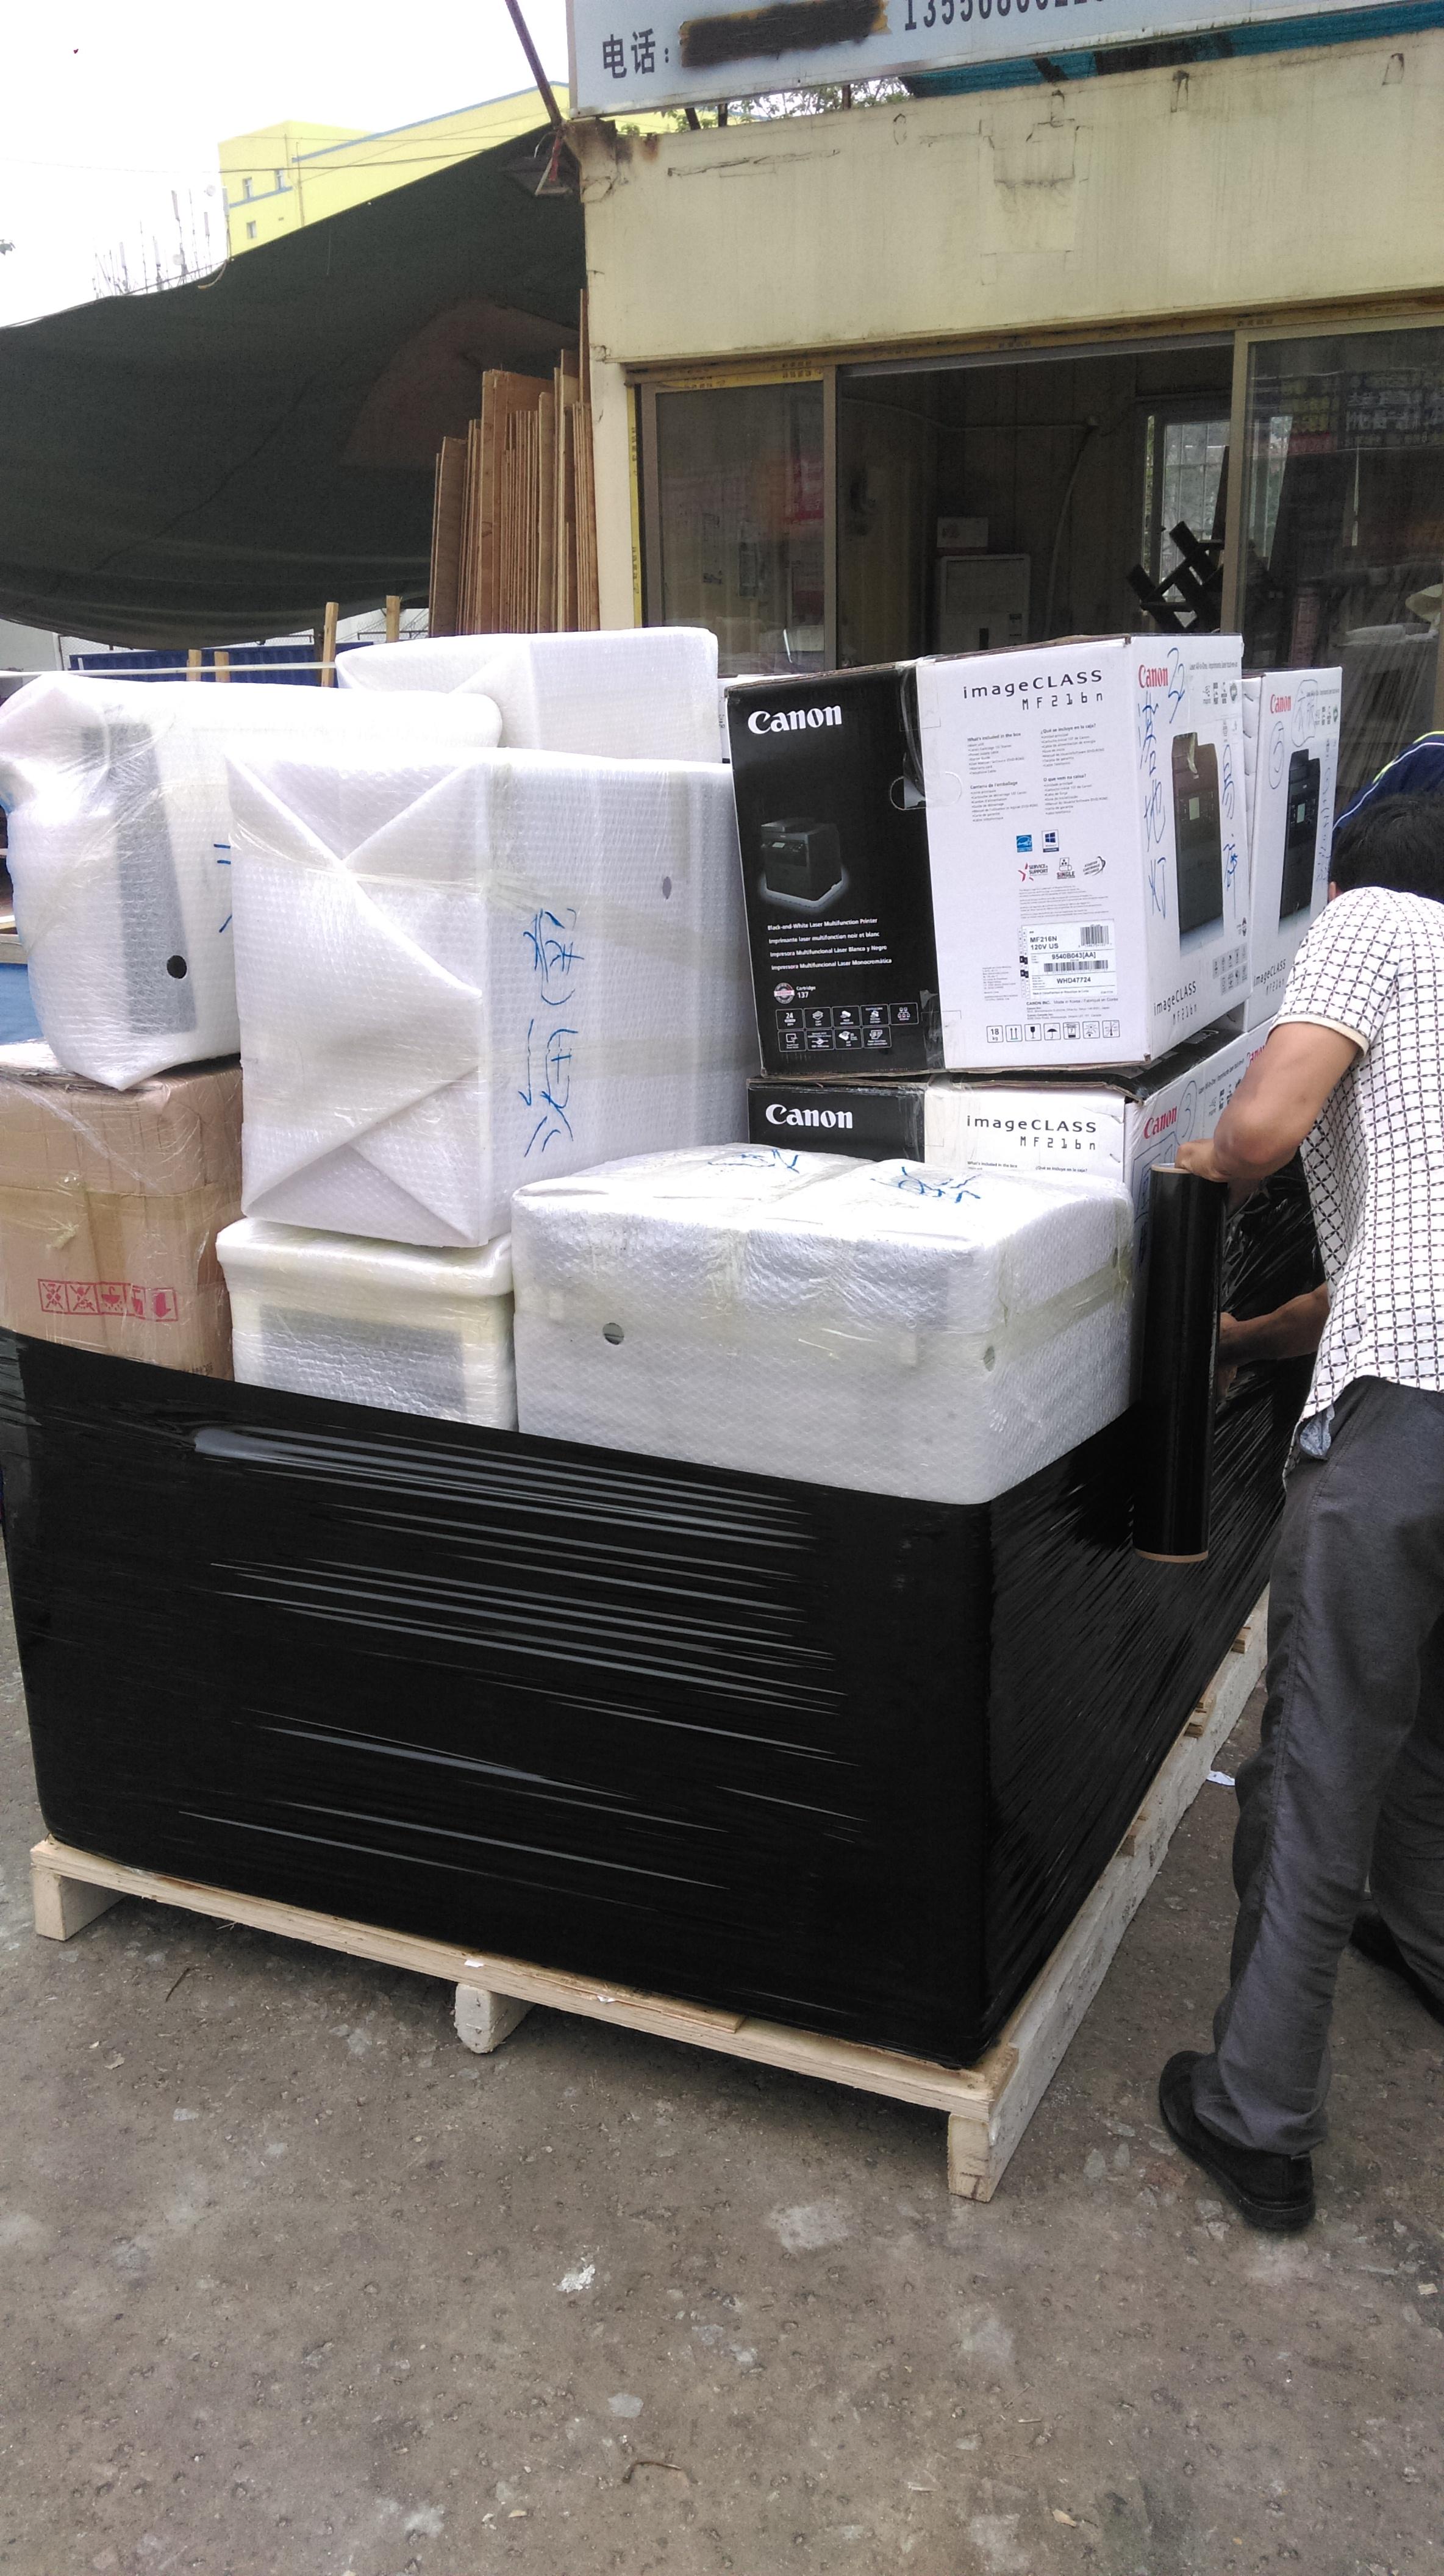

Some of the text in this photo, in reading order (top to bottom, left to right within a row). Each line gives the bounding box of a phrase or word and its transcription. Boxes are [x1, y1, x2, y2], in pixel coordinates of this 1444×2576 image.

[963, 670, 1103, 699] imageCLASS
[1138, 664, 1168, 689] Canon
[1270, 693, 1292, 714] Canon
[748, 705, 842, 734] Canon
[1051, 951, 1096, 960] 9540B043[AA]
[1254, 959, 1286, 987] imageCLASS
[1154, 981, 1196, 1016] imageCLASS
[766, 1104, 852, 1128] Canon
[967, 1115, 1096, 1132] imageCLASS
[1143, 1106, 1178, 1140] Canon
